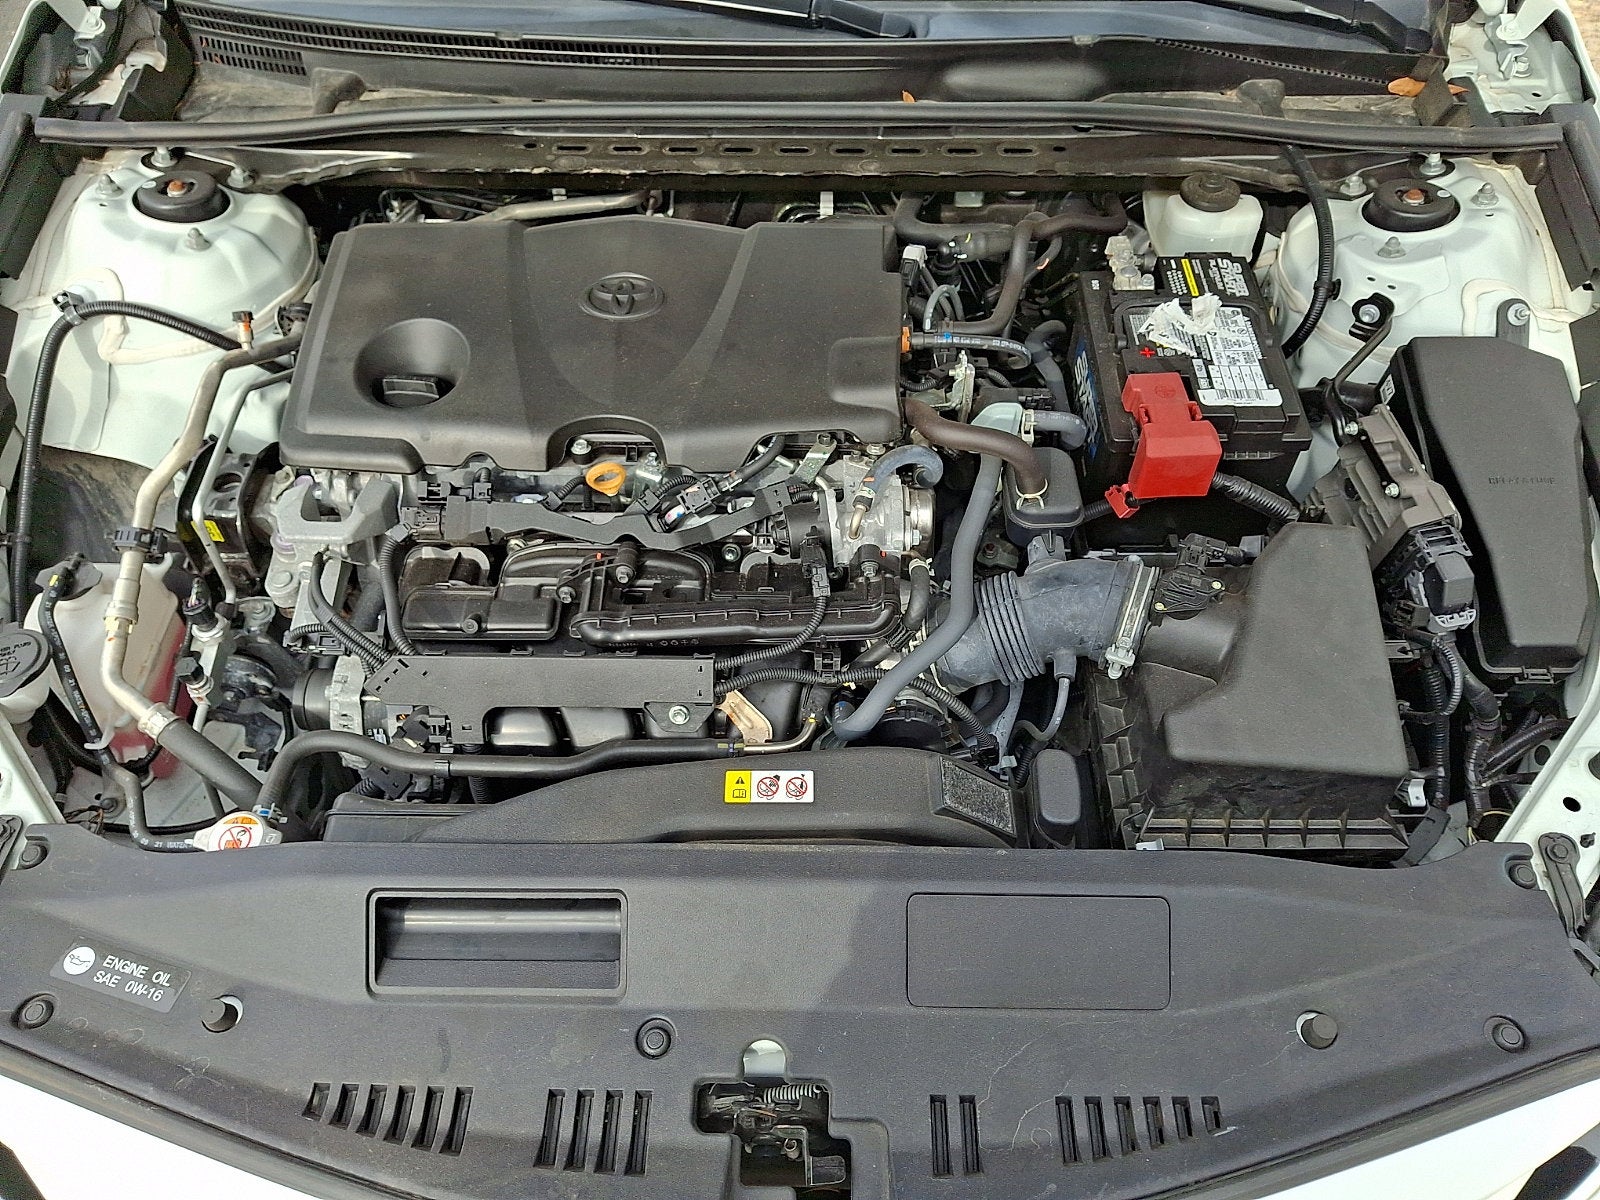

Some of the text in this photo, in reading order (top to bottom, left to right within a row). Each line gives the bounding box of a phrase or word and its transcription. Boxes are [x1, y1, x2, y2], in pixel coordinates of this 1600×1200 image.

[1217, 257, 1237, 297] START
[1231, 261, 1250, 297] SUPER
[93, 970, 164, 1002] SAE 0W-16
[102, 954, 171, 987] ENGINE OIL
